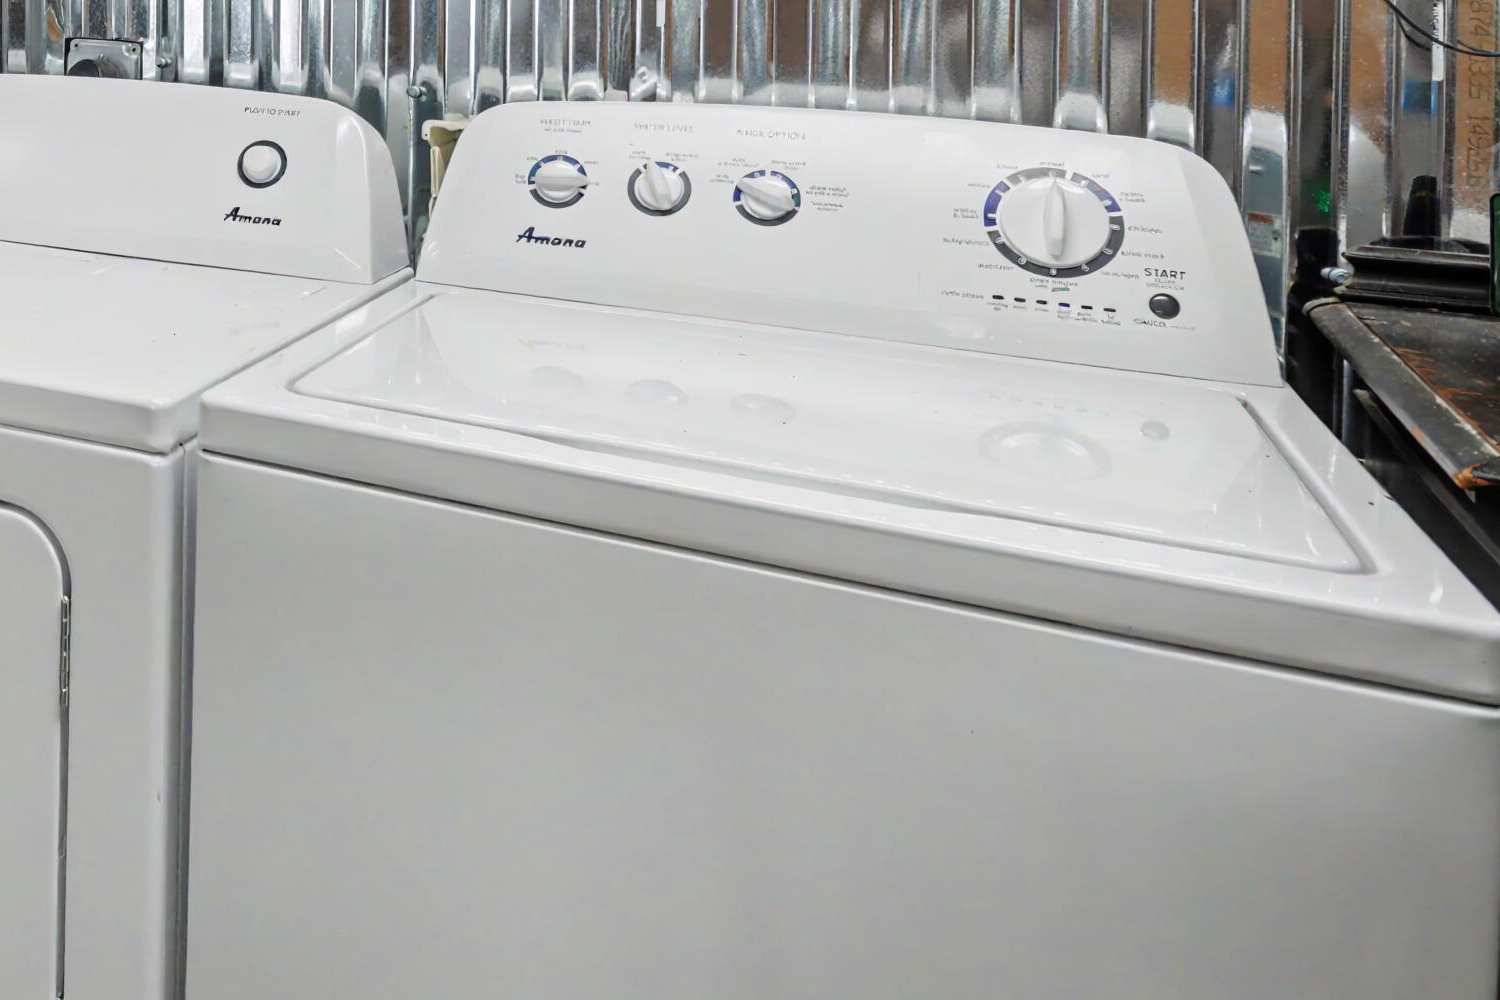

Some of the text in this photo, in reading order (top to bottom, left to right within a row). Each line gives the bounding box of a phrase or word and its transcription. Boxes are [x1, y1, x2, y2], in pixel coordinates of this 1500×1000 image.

[223, 206, 282, 226] Amana
[516, 226, 587, 248] Amana
[1144, 267, 1187, 280] START
